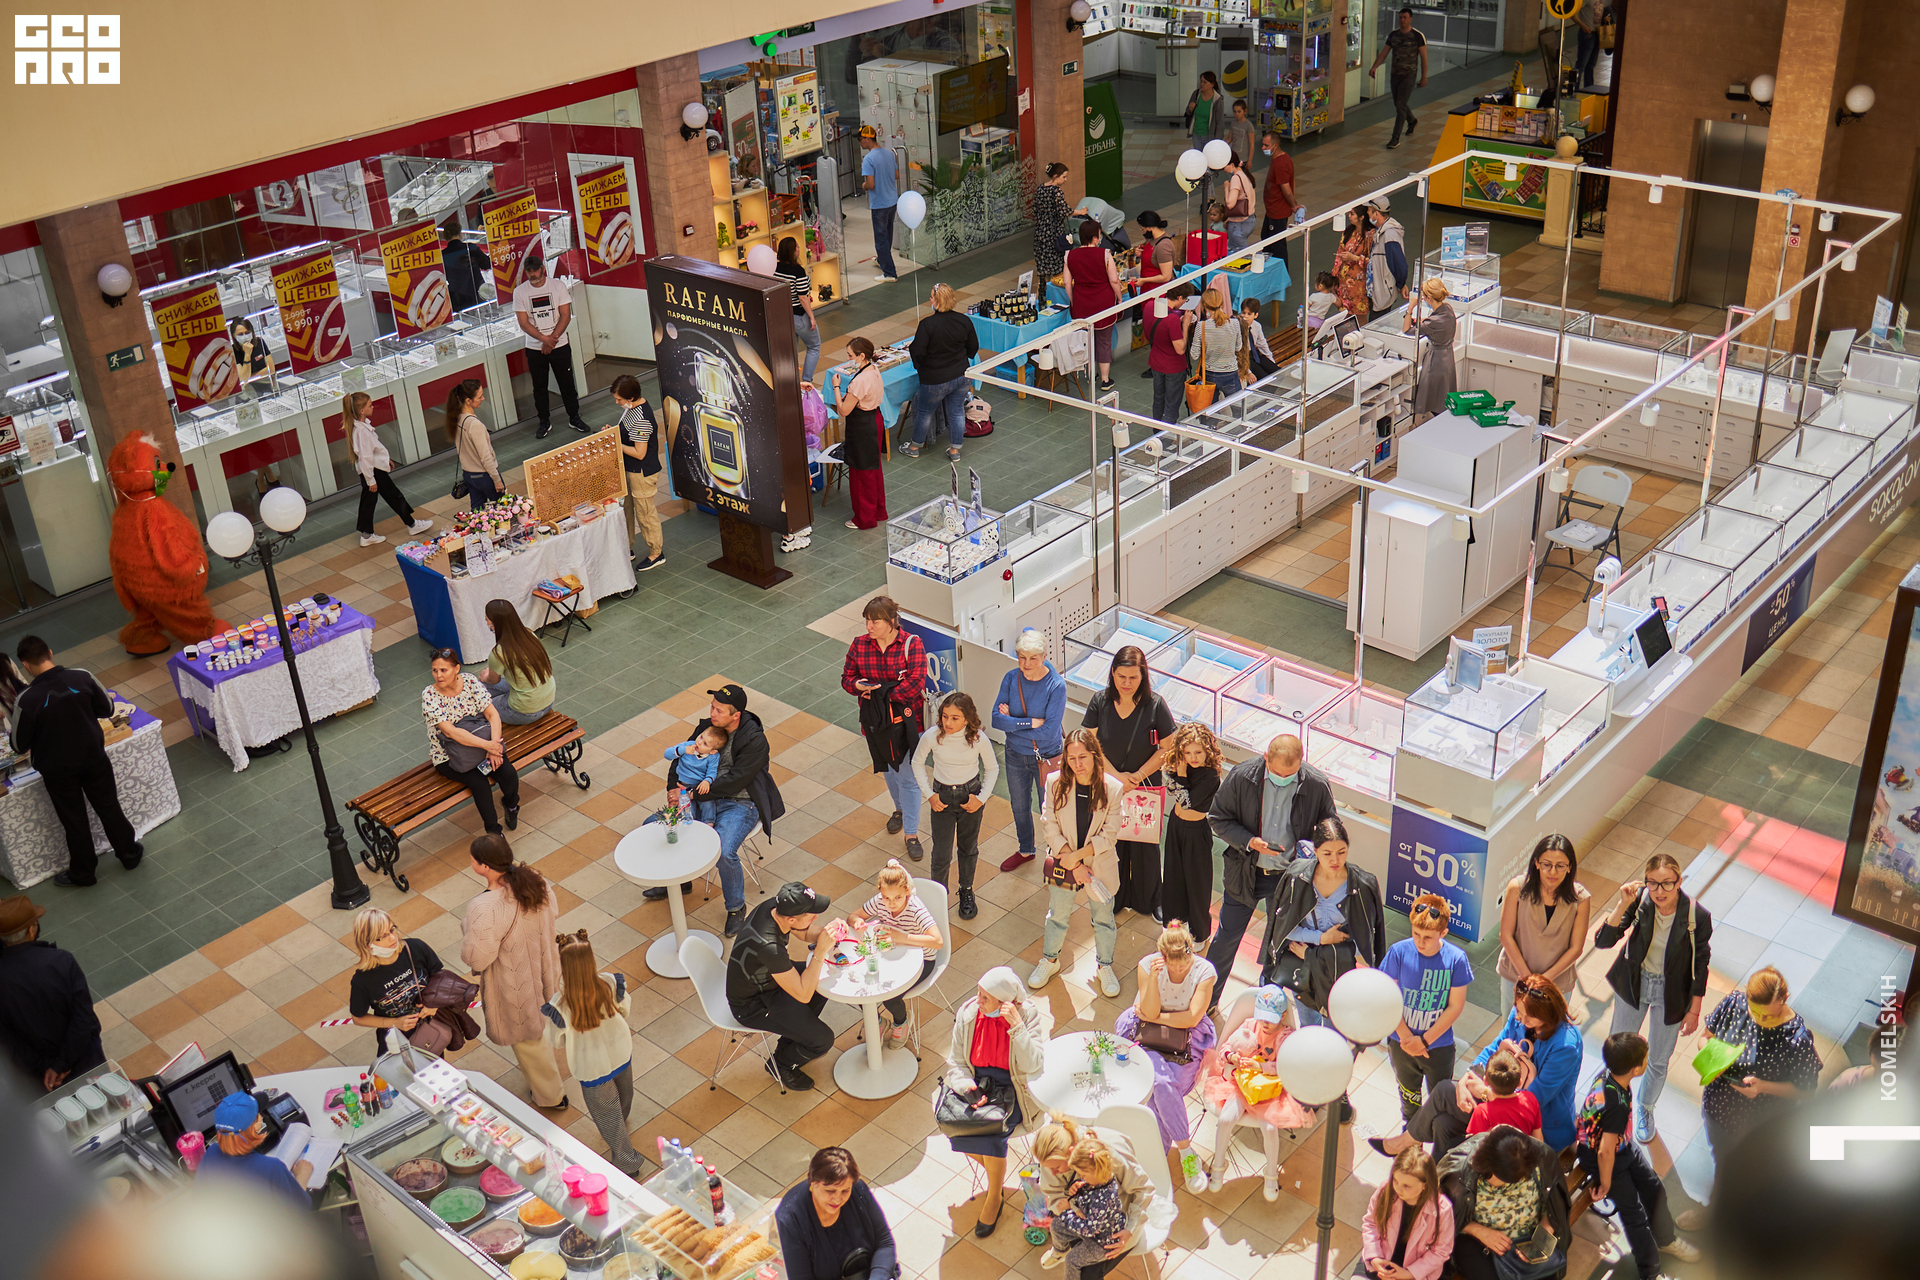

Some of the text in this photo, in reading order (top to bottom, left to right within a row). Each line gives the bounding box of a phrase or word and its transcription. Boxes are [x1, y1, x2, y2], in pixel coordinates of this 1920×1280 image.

[579, 172, 626, 197] СНИЖАЕМ
[485, 199, 536, 226] СНИЖАЕМ
[585, 194, 623, 211] ЦЕНЫ
[492, 221, 533, 240] ЦЕНЫ
[383, 228, 437, 257] СНИЖАЕМ
[391, 251, 435, 271] ЦЕНЫ
[501, 252, 516, 264] 990
[275, 259, 334, 290] СНИЖАЕМ
[284, 283, 331, 304] ЦЕНЫ
[664, 282, 747, 323] RAFAM
[156, 292, 220, 325] СНИЖАЕМ
[166, 317, 218, 340] ЦЕНЫ
[286, 323, 293, 333] 3
[294, 317, 313, 330] 990
[667, 310, 748, 338] ПАРФЮМЕРНЫЕ МАСЛА
[705, 487, 714, 502] 2
[1869, 457, 1920, 523] SOKOLOV
[1768, 612, 1788, 638] ЦЕНЫ
[1404, 881, 1462, 917] ЦЕЫ
[1855, 896, 1882, 916] ДЛЯ
[394, 968, 413, 983] GOING
[1418, 990, 1440, 1011] BE
[1437, 990, 1449, 1010] A
[184, 1072, 217, 1094] r_keeper
